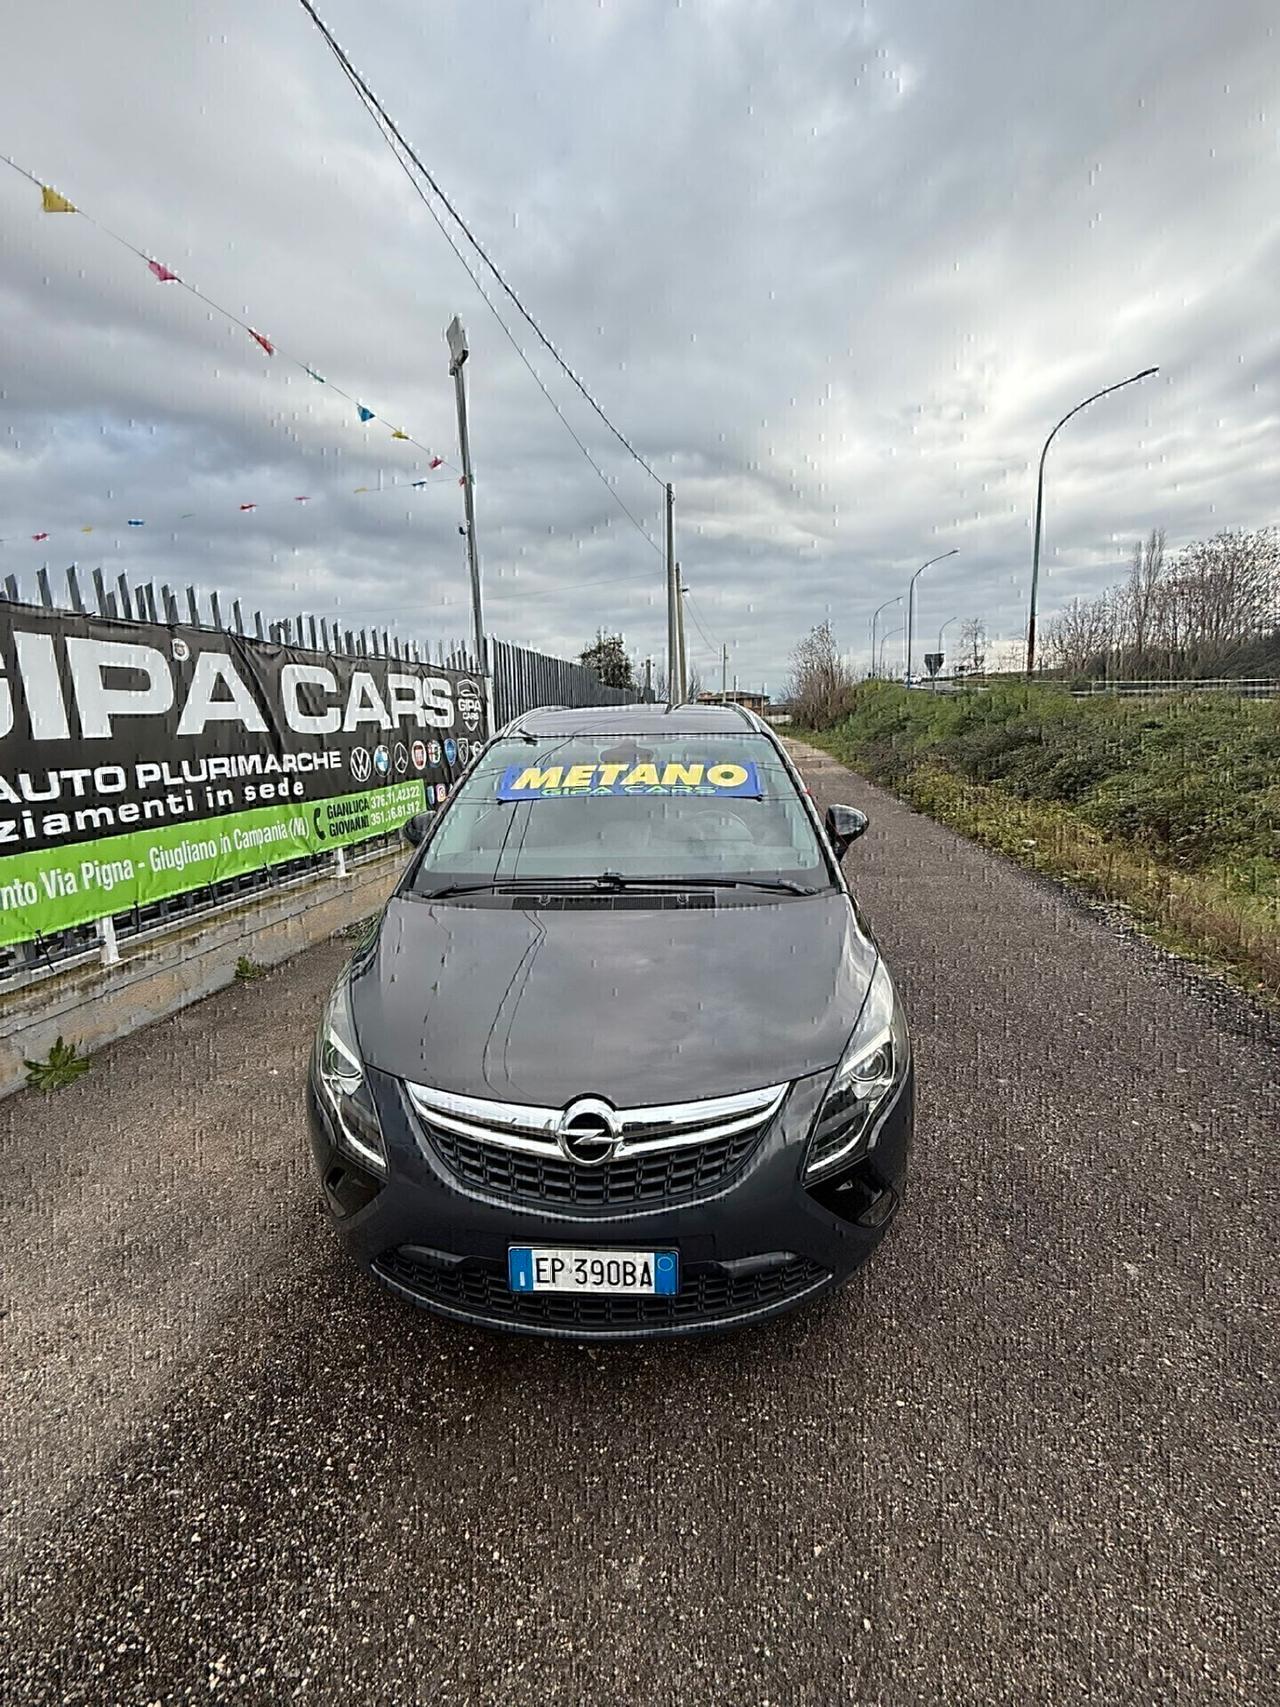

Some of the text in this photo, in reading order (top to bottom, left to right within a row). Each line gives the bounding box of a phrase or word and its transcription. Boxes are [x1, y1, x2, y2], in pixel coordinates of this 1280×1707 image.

[282, 664, 454, 734] CARS
[458, 698, 482, 712] GIPA
[136, 751, 342, 789] PLURIMARCHE
[510, 763, 748, 790] METANO
[206, 789, 234, 808] in
[244, 780, 304, 801] sede
[540, 785, 717, 796] GIPA CARS
[327, 797, 370, 820] GIANLUCA
[328, 814, 370, 837] GIOVANNI
[40, 867, 78, 899] Via
[81, 859, 135, 891] Pigna
[149, 840, 217, 873] Giugliano
[219, 833, 232, 854] in
[233, 819, 288, 850] Campania
[535, 1257, 653, 1287] EP 390BA
